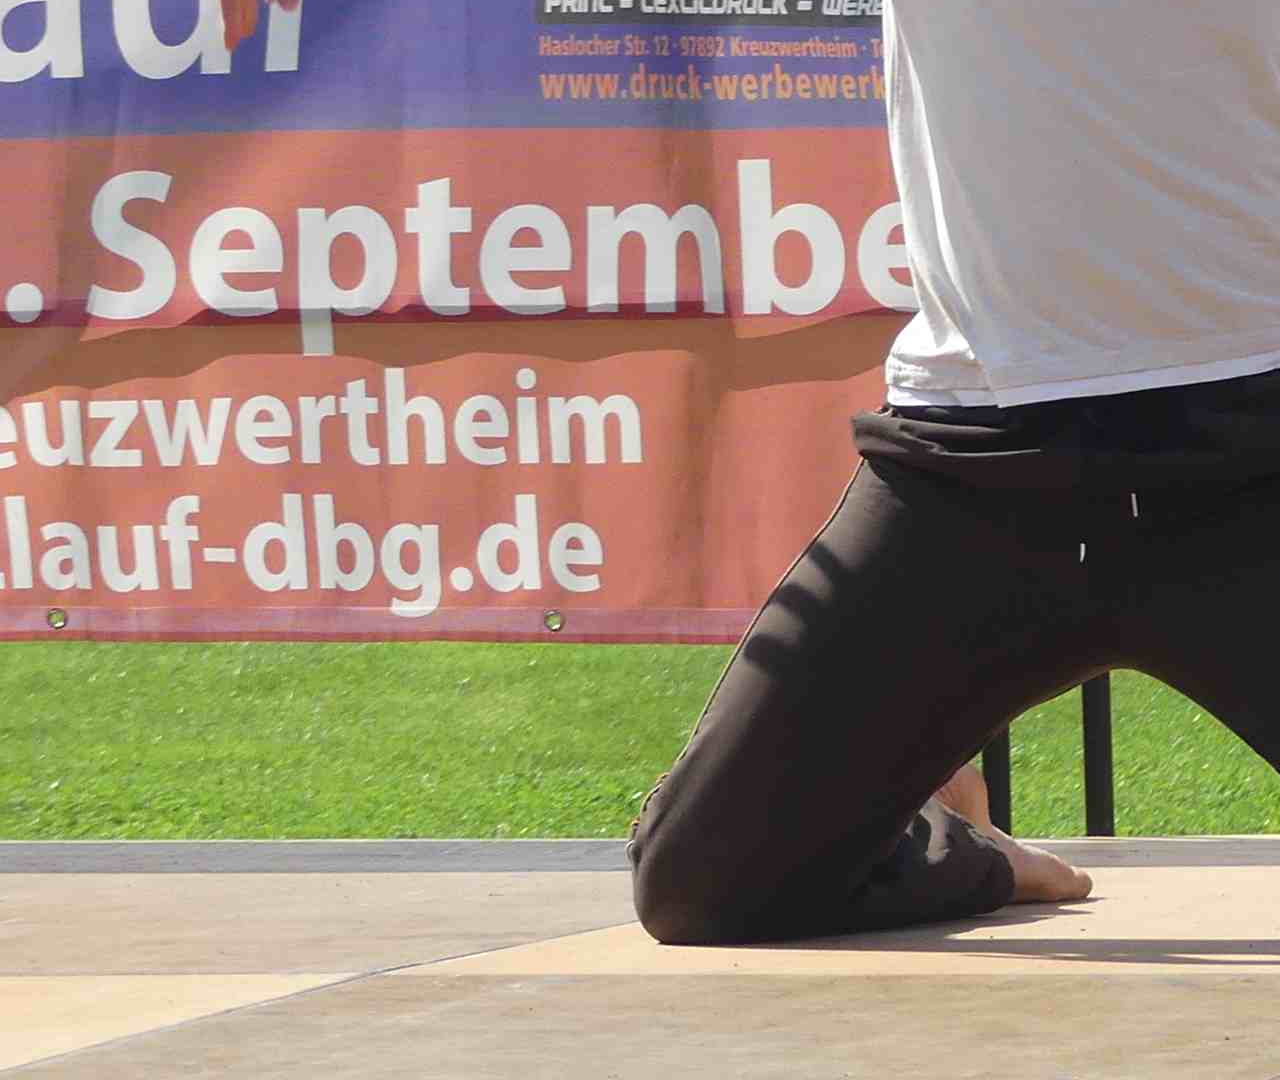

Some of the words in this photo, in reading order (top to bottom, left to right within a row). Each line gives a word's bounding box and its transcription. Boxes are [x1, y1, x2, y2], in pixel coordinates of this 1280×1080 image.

[538, 33, 620, 57] Haslocher
[623, 34, 650, 57] Str.
[654, 35, 670, 57] 12
[679, 35, 725, 57] 97892
[729, 35, 857, 58] Kreuzwertheim
[0, 492, 605, 618] lauf-dbg.de
